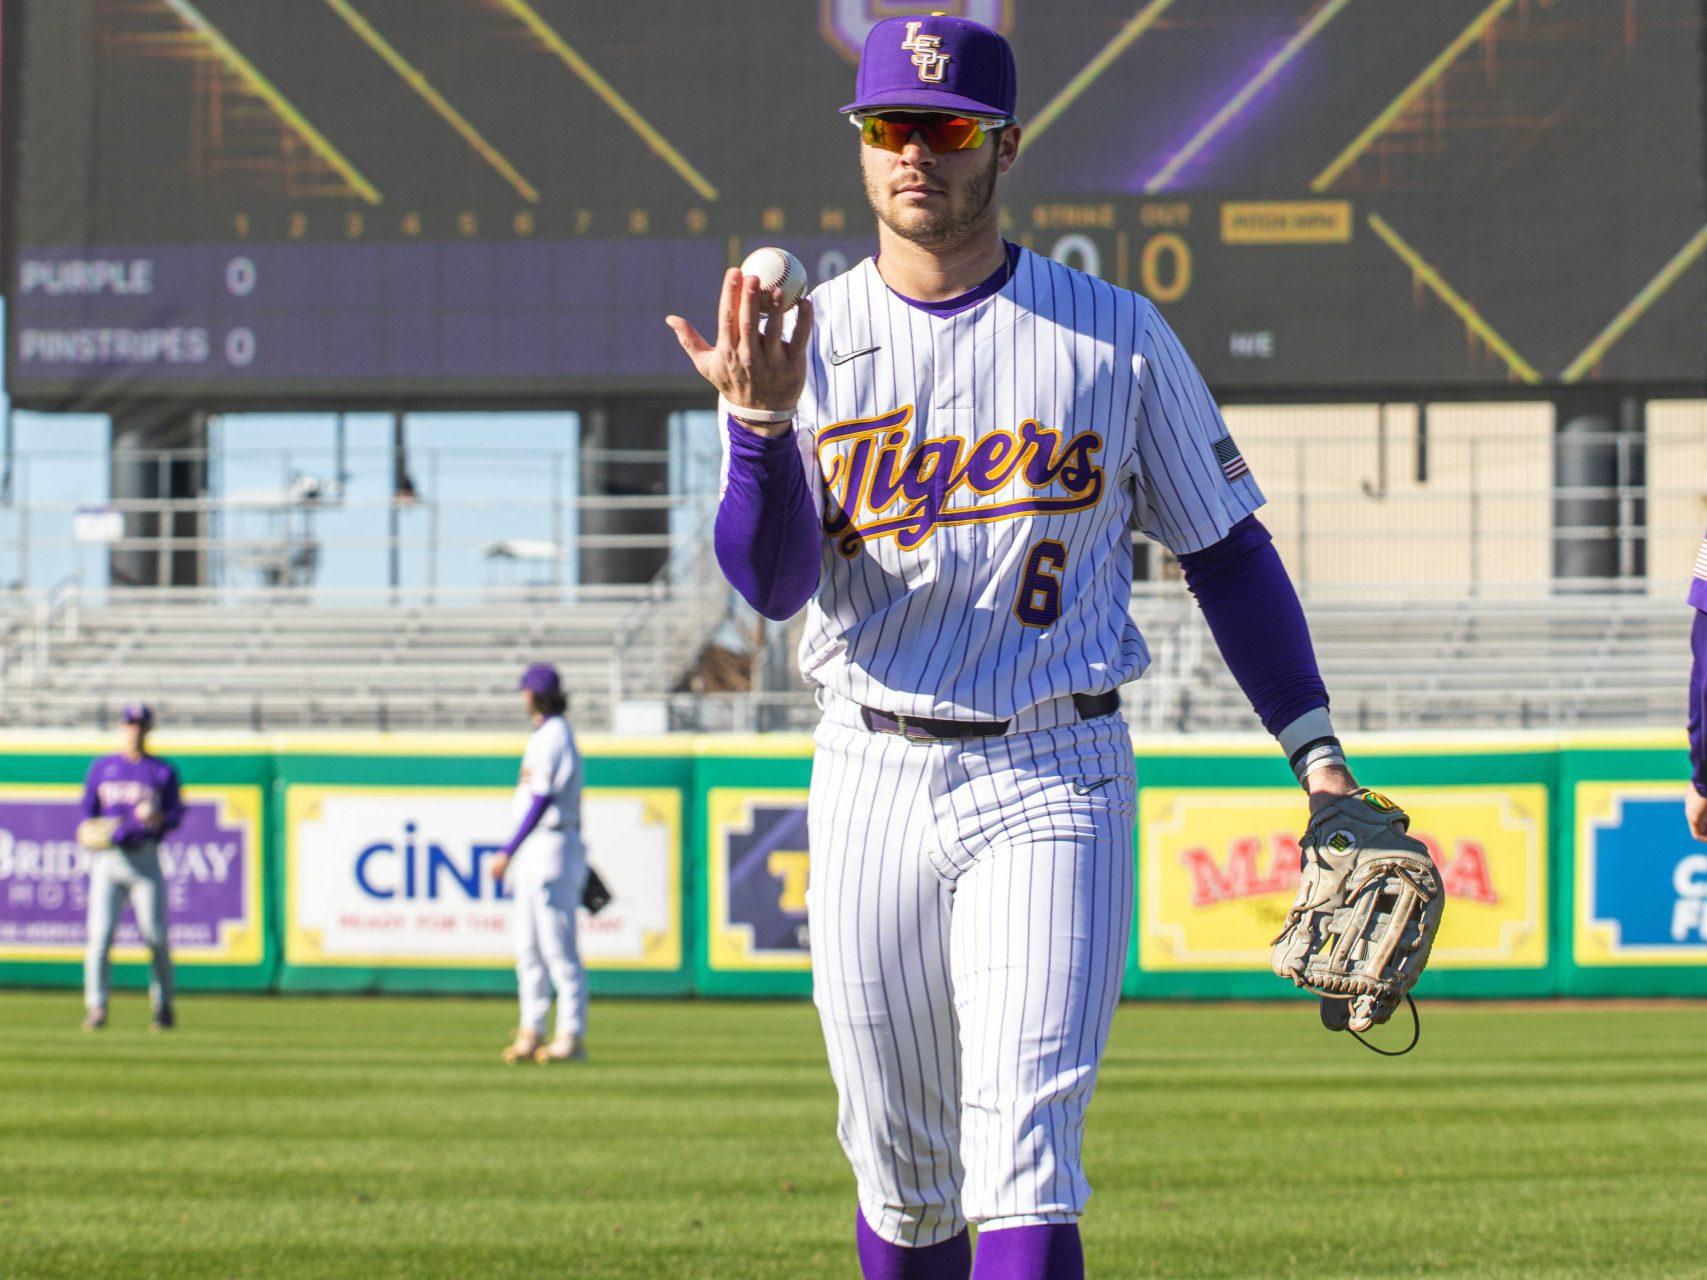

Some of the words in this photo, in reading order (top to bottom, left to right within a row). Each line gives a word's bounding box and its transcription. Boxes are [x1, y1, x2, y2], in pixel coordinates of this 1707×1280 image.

[901, 21, 952, 83] LSU
[1032, 204, 1116, 228] STRIKE
[1140, 202, 1192, 226] OUT
[20, 258, 154, 296] PURPLE
[224, 256, 257, 298] 0
[1141, 233, 1192, 302] 0
[19, 327, 210, 364] PINSTRIPES
[225, 326, 256, 367] 0
[816, 404, 1104, 560] Tigers
[1013, 538, 1067, 628] 6
